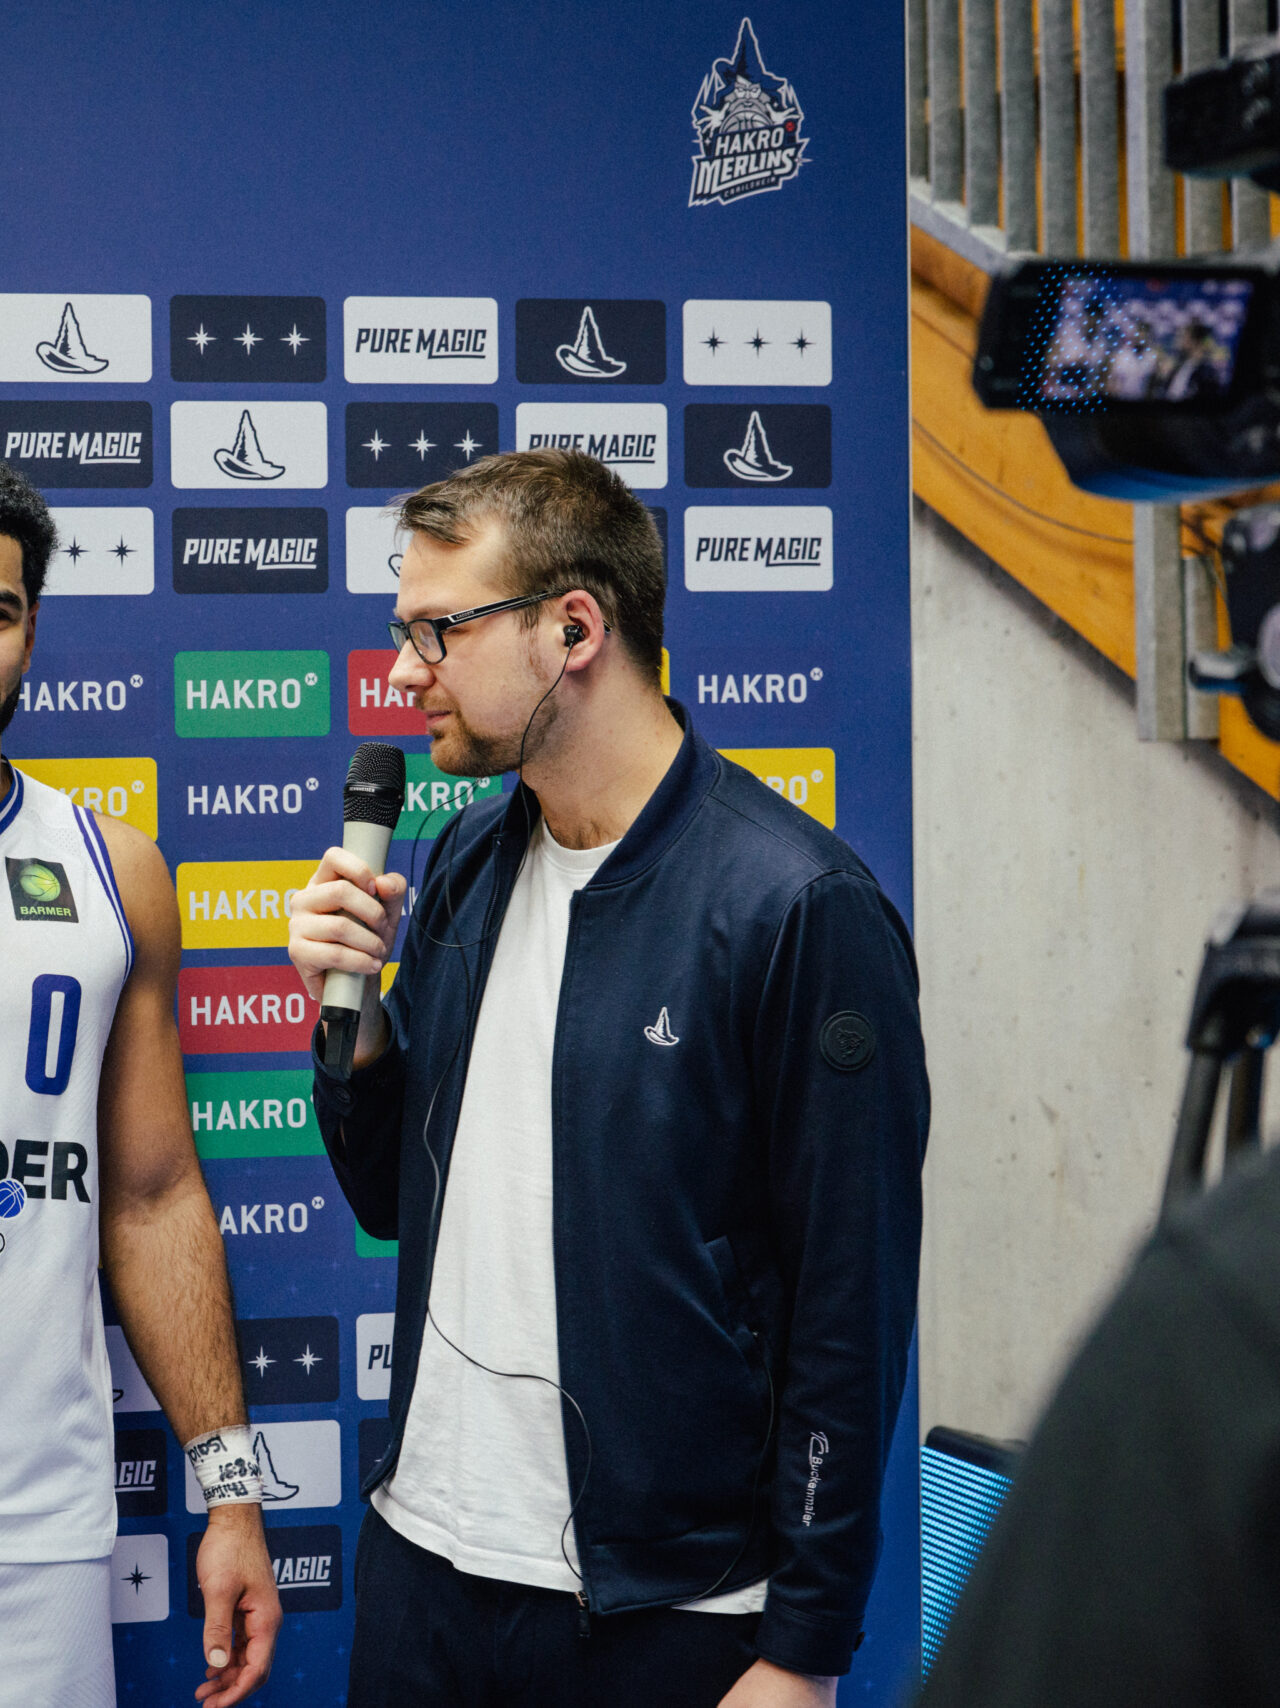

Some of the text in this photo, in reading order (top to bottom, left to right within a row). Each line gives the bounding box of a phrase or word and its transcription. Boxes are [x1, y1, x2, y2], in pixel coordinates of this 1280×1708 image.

[714, 127, 785, 157] HAKRO
[696, 147, 796, 195] MERLINS
[356, 327, 488, 359] PURE MAGIC
[4, 431, 143, 464] PURE MAGIC
[587, 434, 657, 464] MAGIC
[183, 537, 318, 570] PURE MAGIC
[696, 536, 822, 567] PURE MAGIC
[18, 679, 127, 712] HAKRO
[186, 678, 302, 710] HAKRO
[698, 673, 808, 704] HAKRO
[187, 783, 303, 816] HAKRO
[400, 781, 475, 812] KRO
[19, 905, 72, 918] BARMER
[190, 993, 305, 1027] HAKRO
[25, 973, 82, 1096] 0
[191, 1097, 308, 1132] HAKRO
[220, 1202, 309, 1235] AKRO
[114, 1459, 157, 1493] GIC
